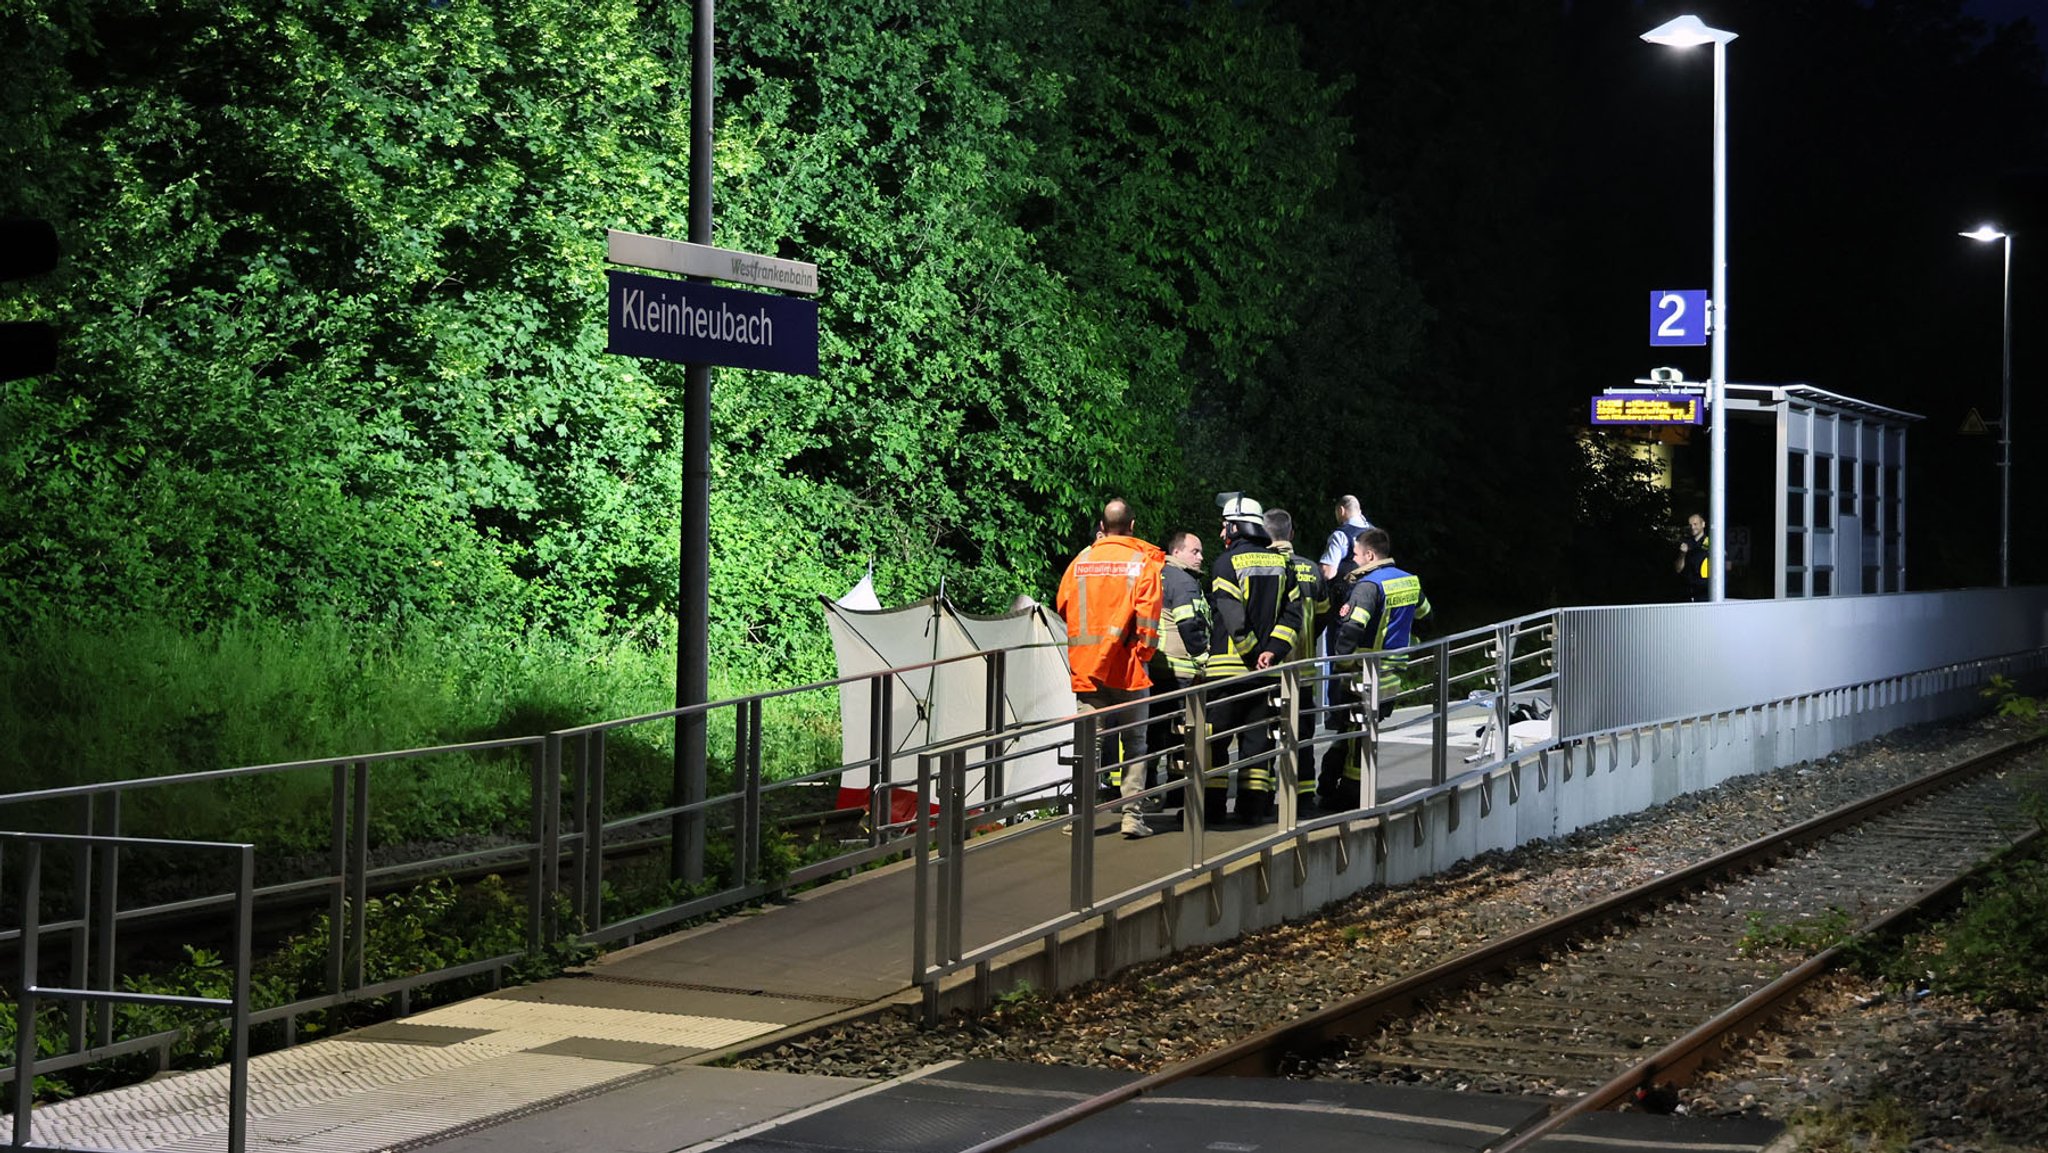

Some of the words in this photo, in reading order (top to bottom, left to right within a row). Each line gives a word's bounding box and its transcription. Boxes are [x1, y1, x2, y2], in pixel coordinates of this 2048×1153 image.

[731, 258, 813, 287] Westfrankenbahn
[622, 287, 773, 346] Kleinheubach
[1657, 294, 1685, 336] 2
